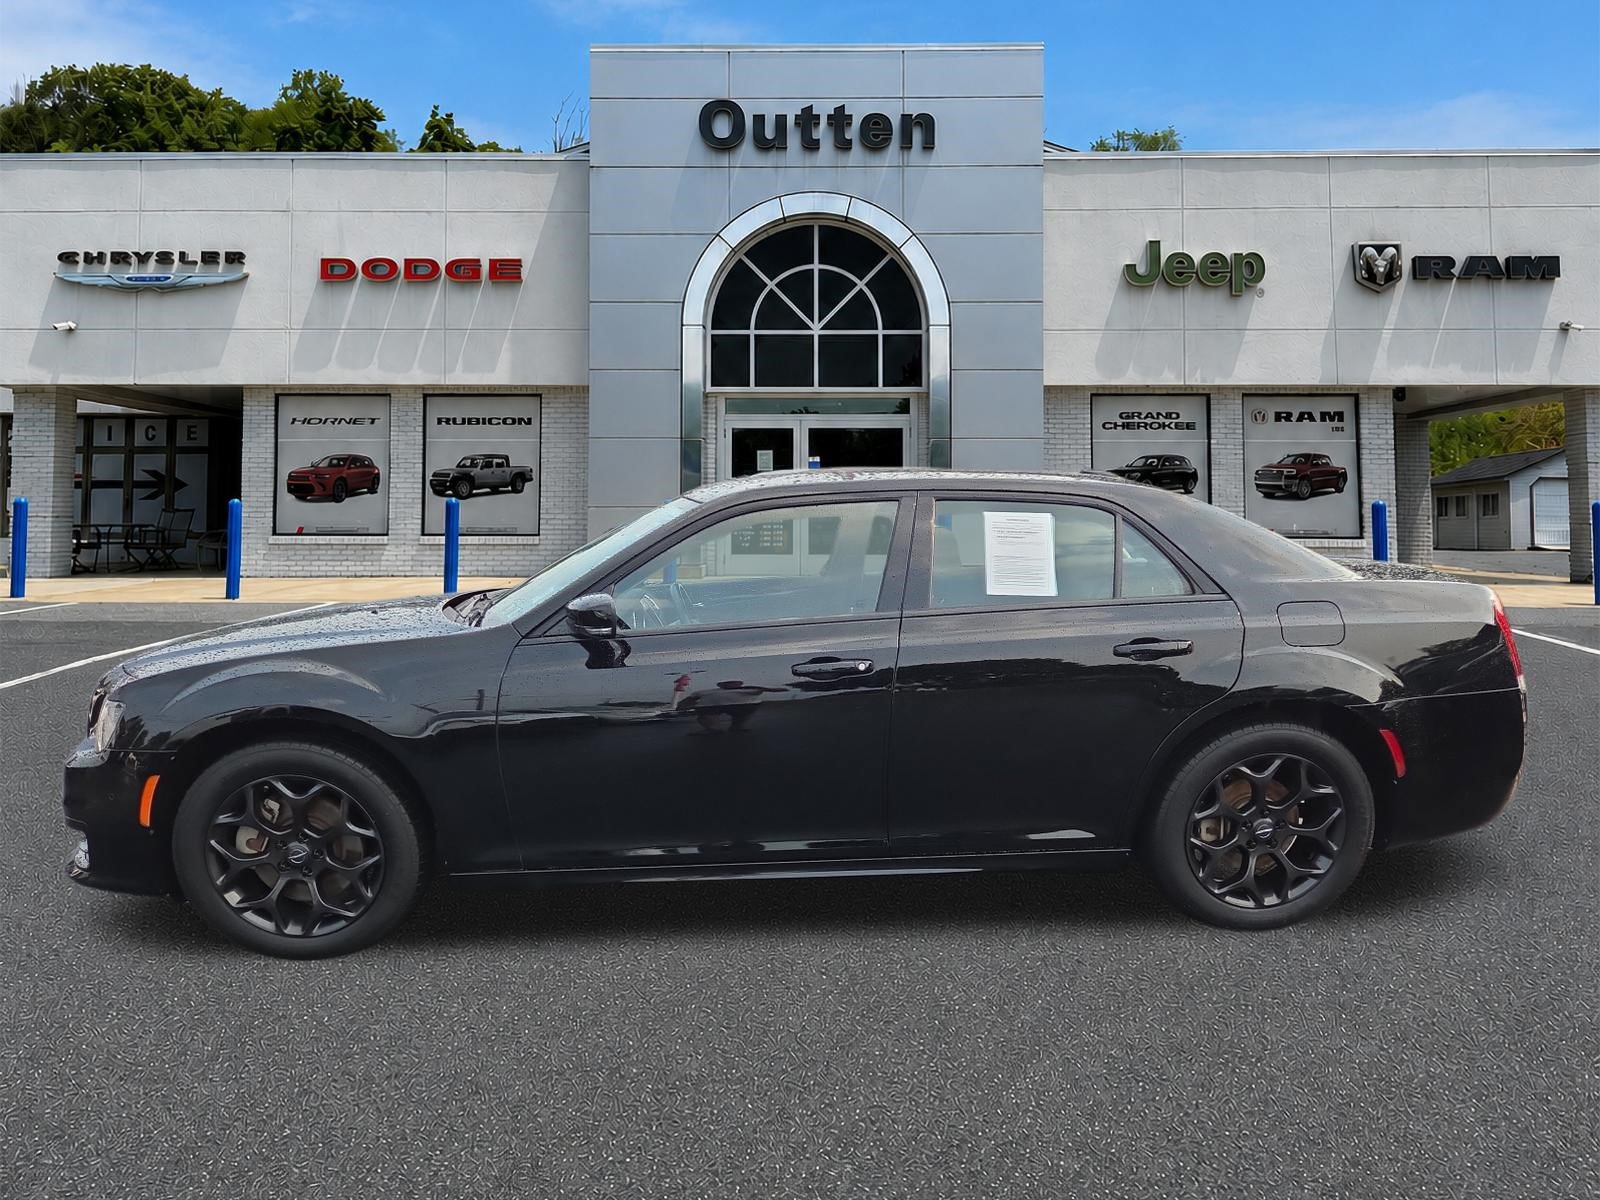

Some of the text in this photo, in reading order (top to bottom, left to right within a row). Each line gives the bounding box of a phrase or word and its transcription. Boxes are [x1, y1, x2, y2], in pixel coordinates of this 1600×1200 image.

[698, 98, 936, 150] Outten
[57, 251, 247, 266] CHRYSLER
[320, 257, 523, 283] DODGE
[1123, 240, 1266, 297] Jeep
[1411, 255, 1561, 280] RAM
[290, 417, 381, 426] HORNET
[436, 416, 533, 426] RUBICON
[1118, 411, 1181, 420] GRAND
[1274, 411, 1345, 423] RAM
[1101, 421, 1197, 431] CHEROKEE
